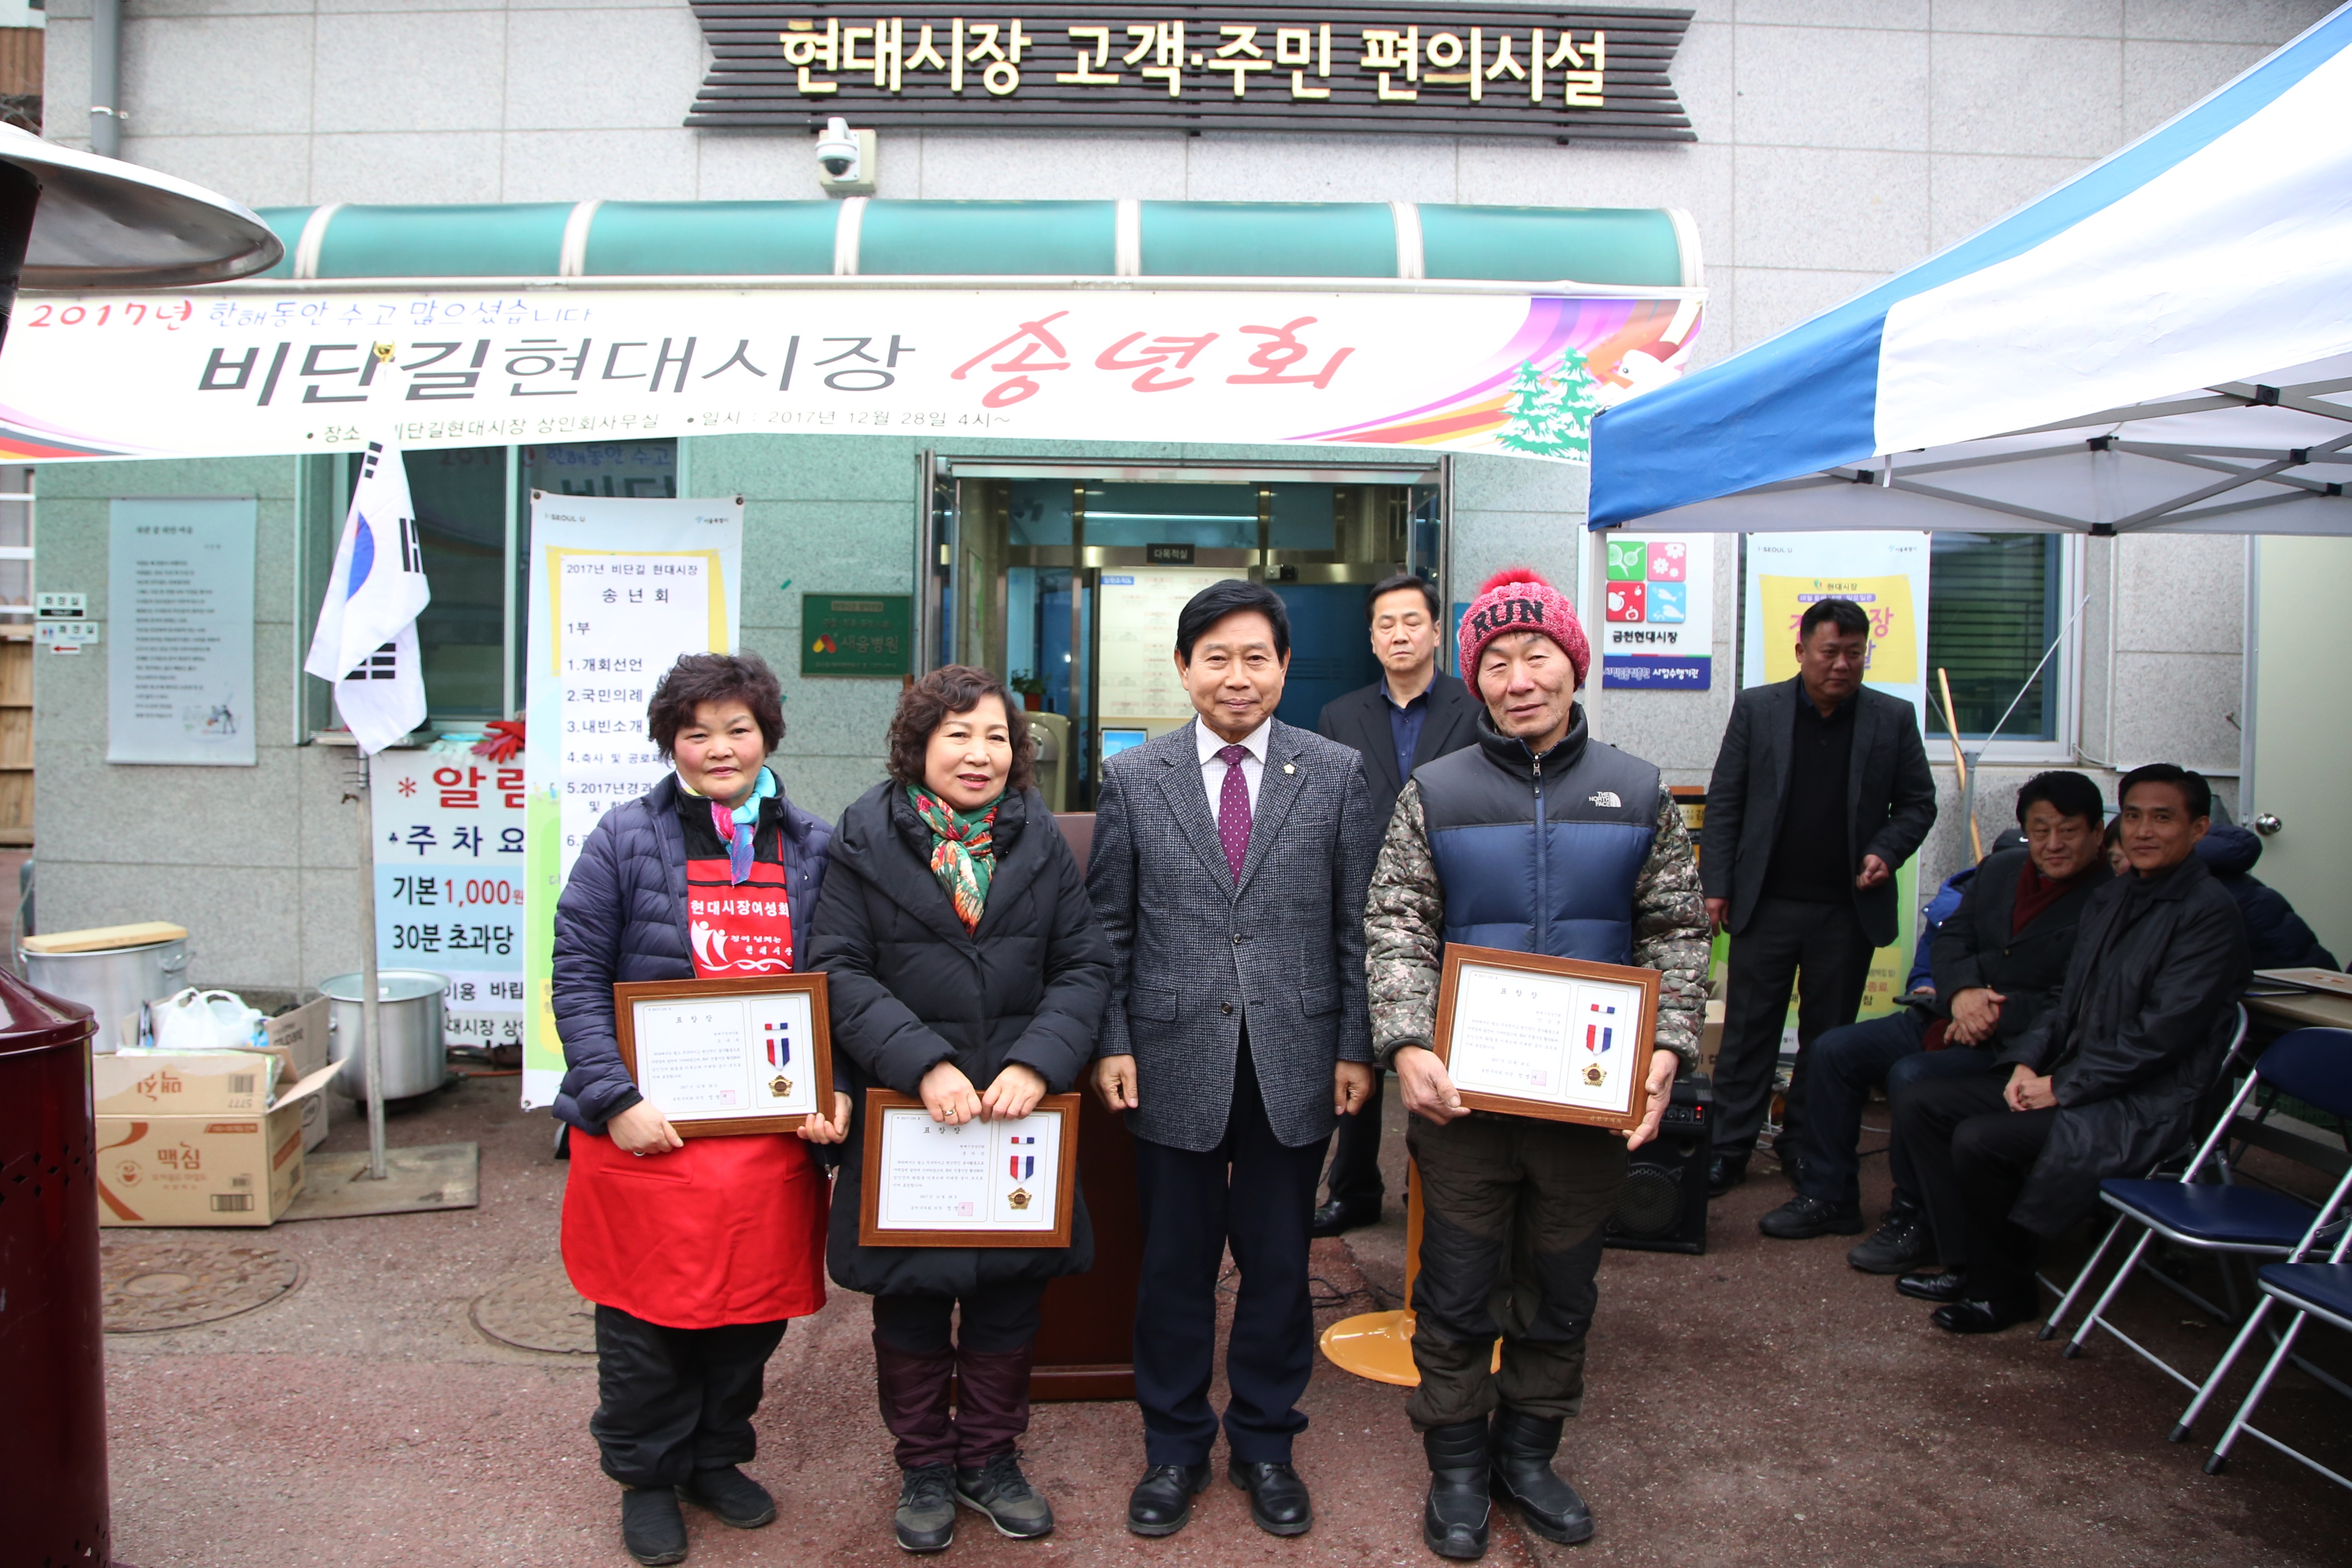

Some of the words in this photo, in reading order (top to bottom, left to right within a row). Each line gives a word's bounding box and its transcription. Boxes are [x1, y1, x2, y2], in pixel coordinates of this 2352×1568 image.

[779, 17, 1032, 96] 현대시장
[1360, 25, 1606, 107] 편의시설
[28, 299, 193, 331] 2017년
[209, 300, 330, 328] 한해동안
[342, 303, 397, 328] 수고
[409, 298, 593, 328] 많으셨습니다
[949, 310, 1356, 409] 송년회
[702, 410, 740, 426] 일시
[768, 410, 836, 426] 2017년
[848, 410, 891, 427] 12월
[901, 410, 947, 428] 28일
[323, 425, 360, 443] 장소
[537, 413, 659, 434] 상인회사무실
[567, 564, 605, 575] 2017년
[611, 564, 645, 575] 비단길
[653, 564, 698, 576] 현대시장
[1827, 583, 1858, 591] 현대시장
[1472, 599, 1545, 642] RUN
[567, 622, 590, 635] 1부
[1612, 630, 1678, 644] 금천현대시장
[567, 658, 643, 672] 1.개회선언
[1652, 667, 1700, 680] 사업수행기관
[567, 689, 643, 703] 2.국민의례
[567, 720, 643, 733] 3.내빈소개
[611, 753, 621, 763] 및
[589, 800, 601, 813] 및
[393, 876, 439, 906] 기본
[690, 900, 790, 917] 현대시장여성회
[158, 1143, 201, 1170] 맥심
